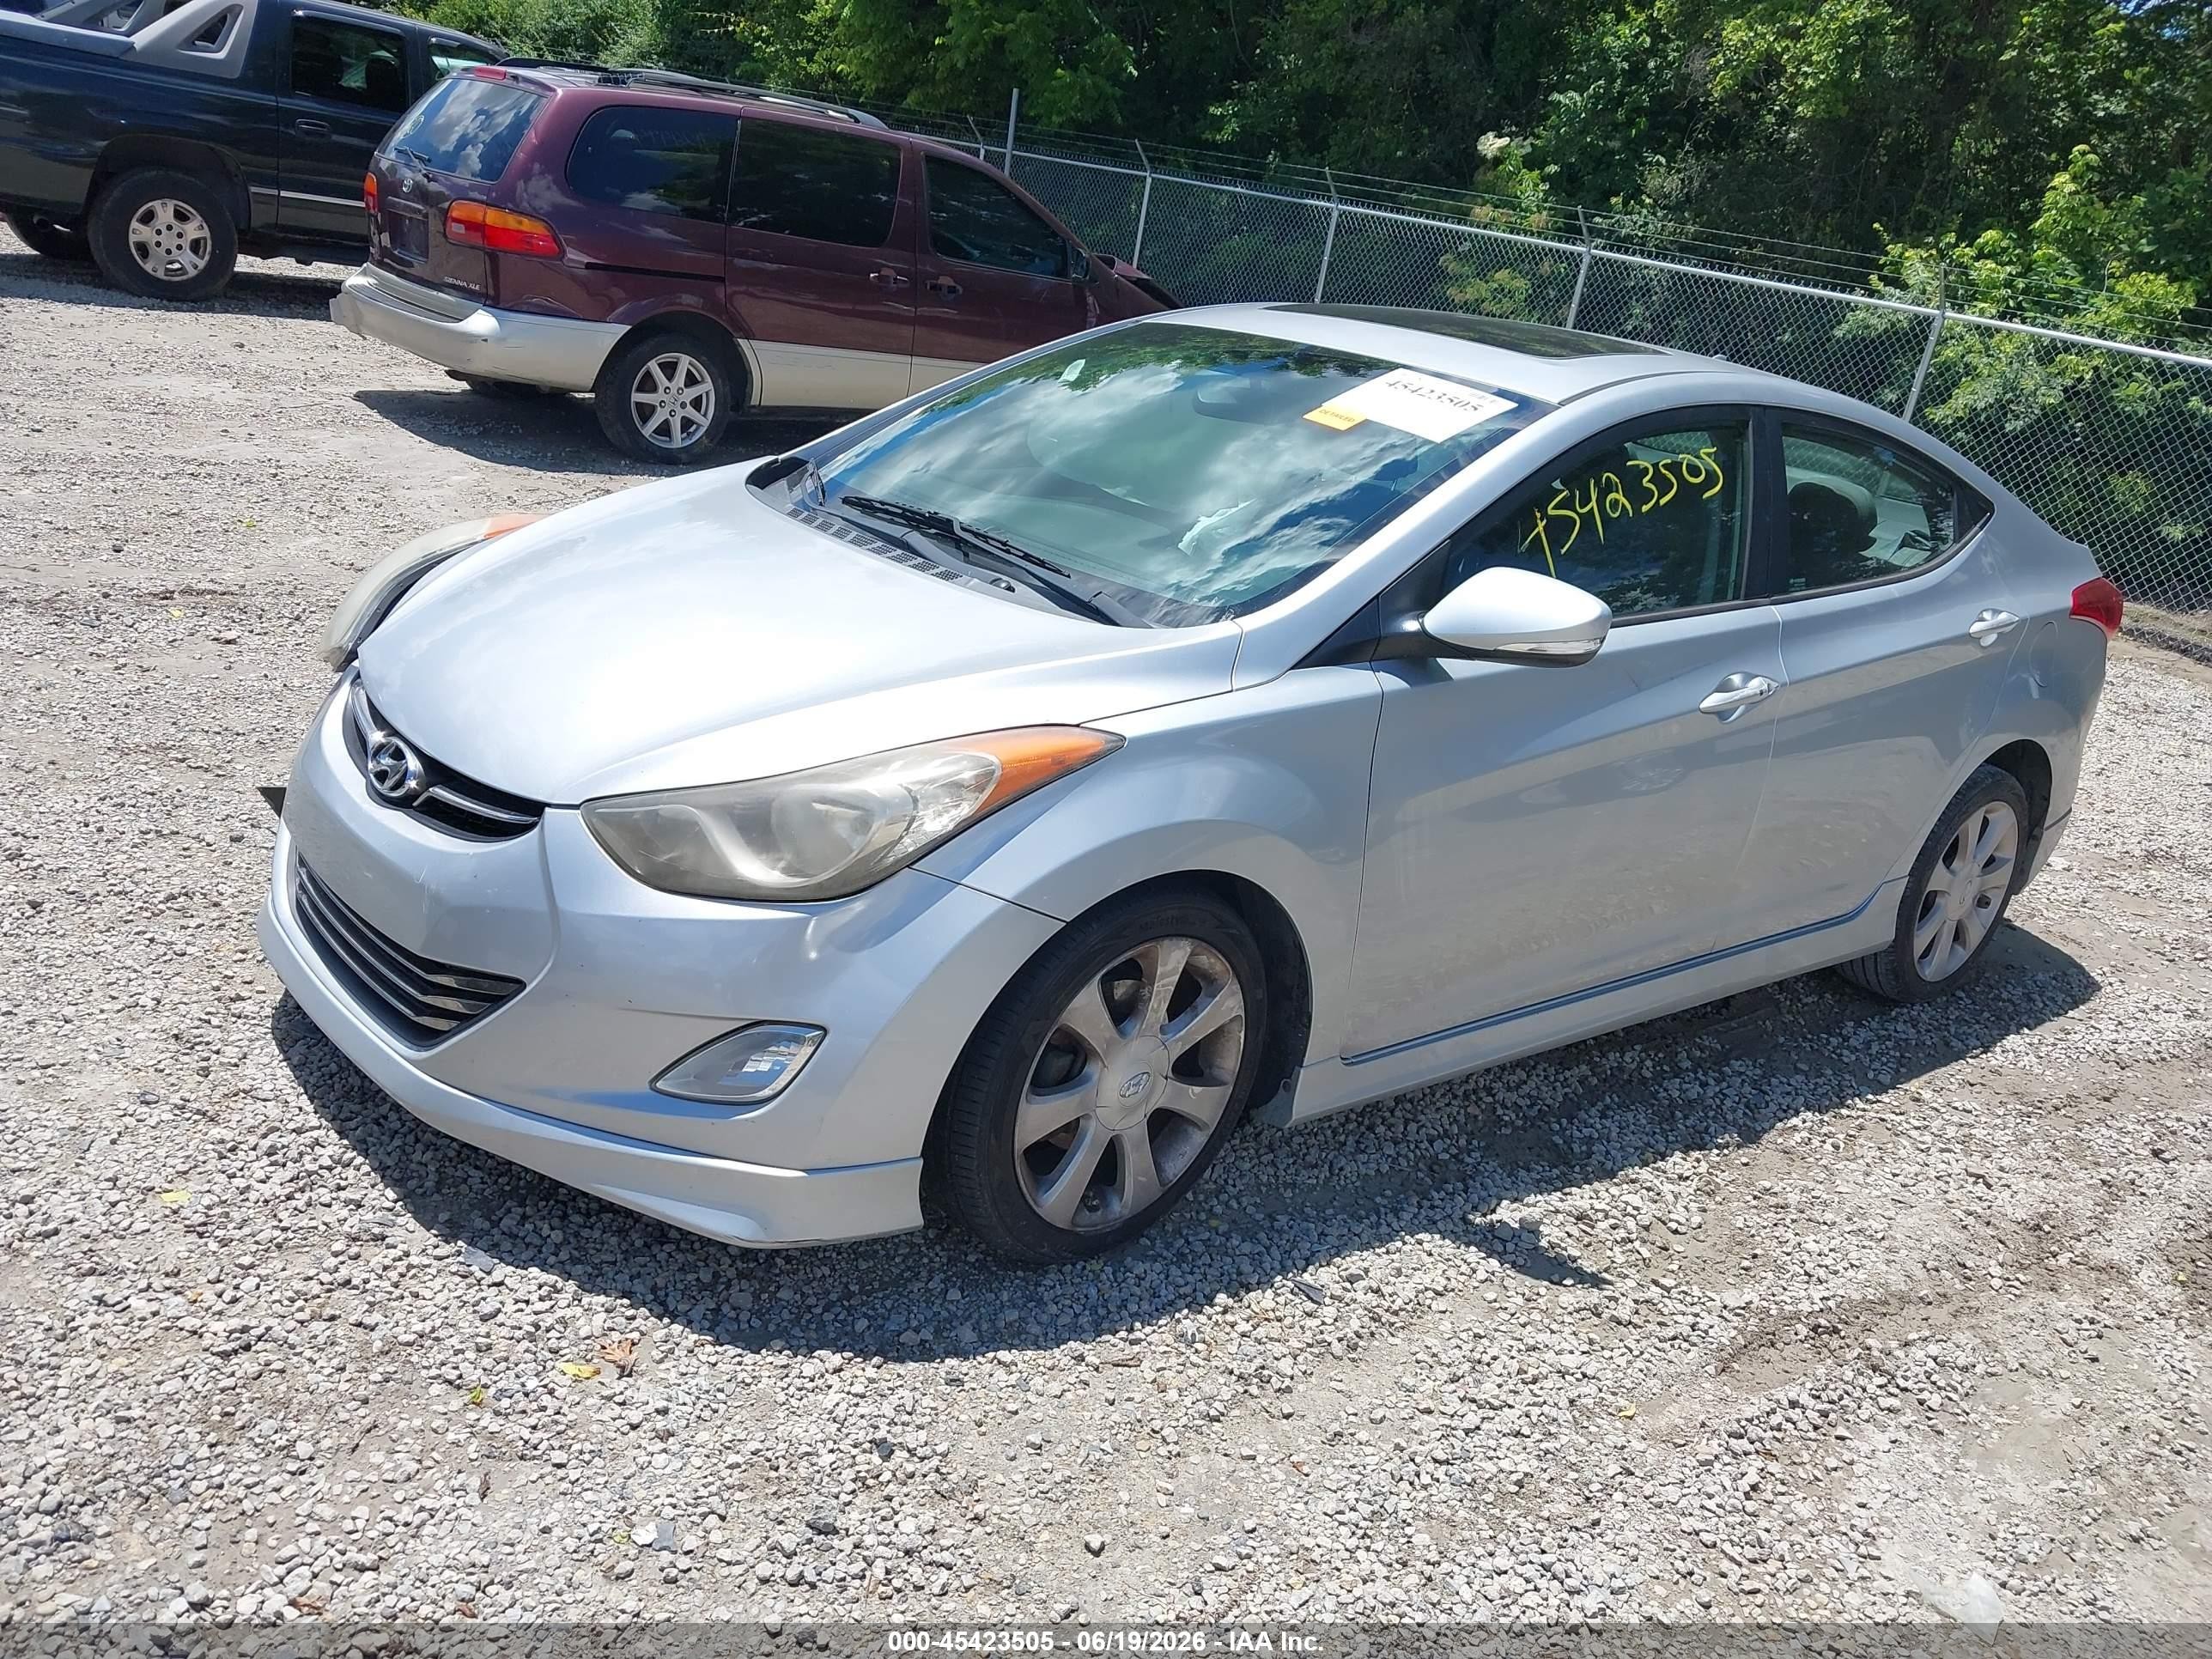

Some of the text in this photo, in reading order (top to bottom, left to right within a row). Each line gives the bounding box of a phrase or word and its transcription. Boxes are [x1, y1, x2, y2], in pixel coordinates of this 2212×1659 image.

[443, 276, 481, 290] SIENNA XLE
[1385, 380, 1485, 412] 45423505
[1318, 409, 1356, 422] DETAILED
[1517, 447, 1724, 578] 45423505
